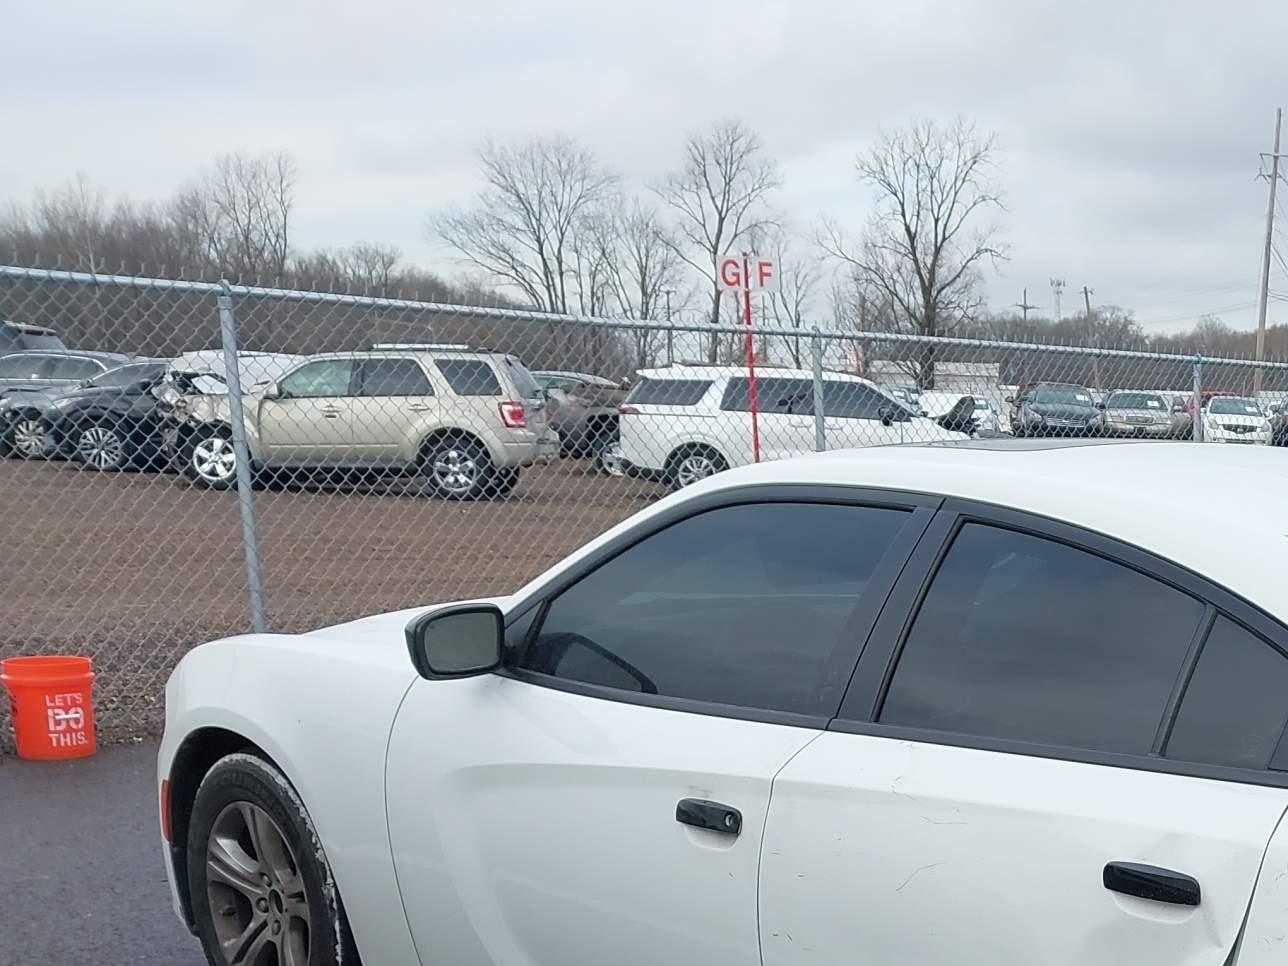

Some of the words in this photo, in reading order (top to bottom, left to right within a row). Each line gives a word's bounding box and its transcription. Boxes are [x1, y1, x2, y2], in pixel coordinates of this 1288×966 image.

[721, 259, 741, 287] G
[758, 261, 773, 288] F
[47, 707, 85, 731] DO
